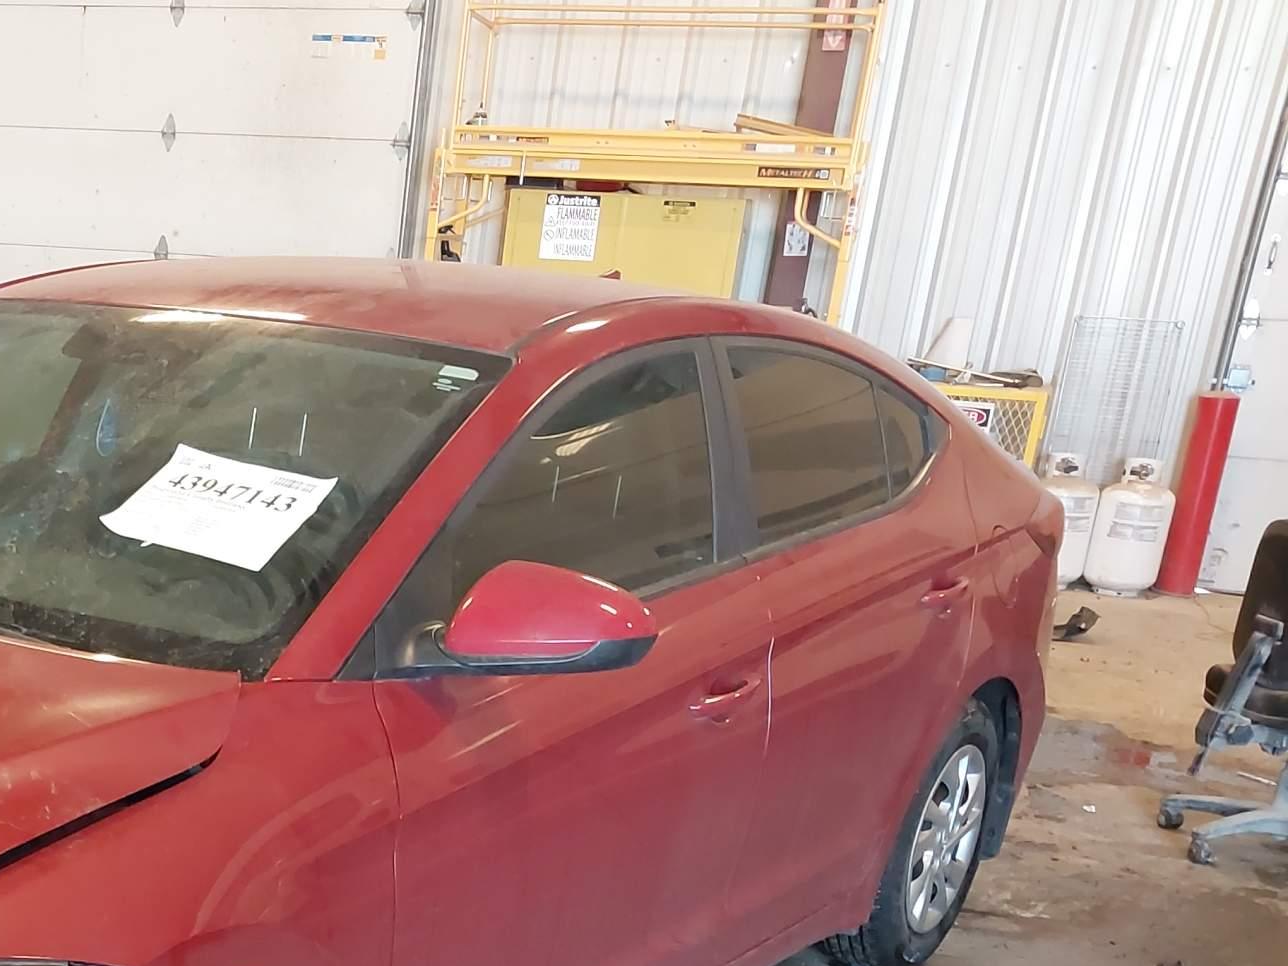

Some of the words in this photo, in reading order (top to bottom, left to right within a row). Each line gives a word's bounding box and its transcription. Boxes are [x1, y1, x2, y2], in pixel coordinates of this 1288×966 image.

[560, 195, 598, 206] Justrite
[557, 207, 597, 220] FLAMMABLE
[168, 473, 297, 512] 43947143
